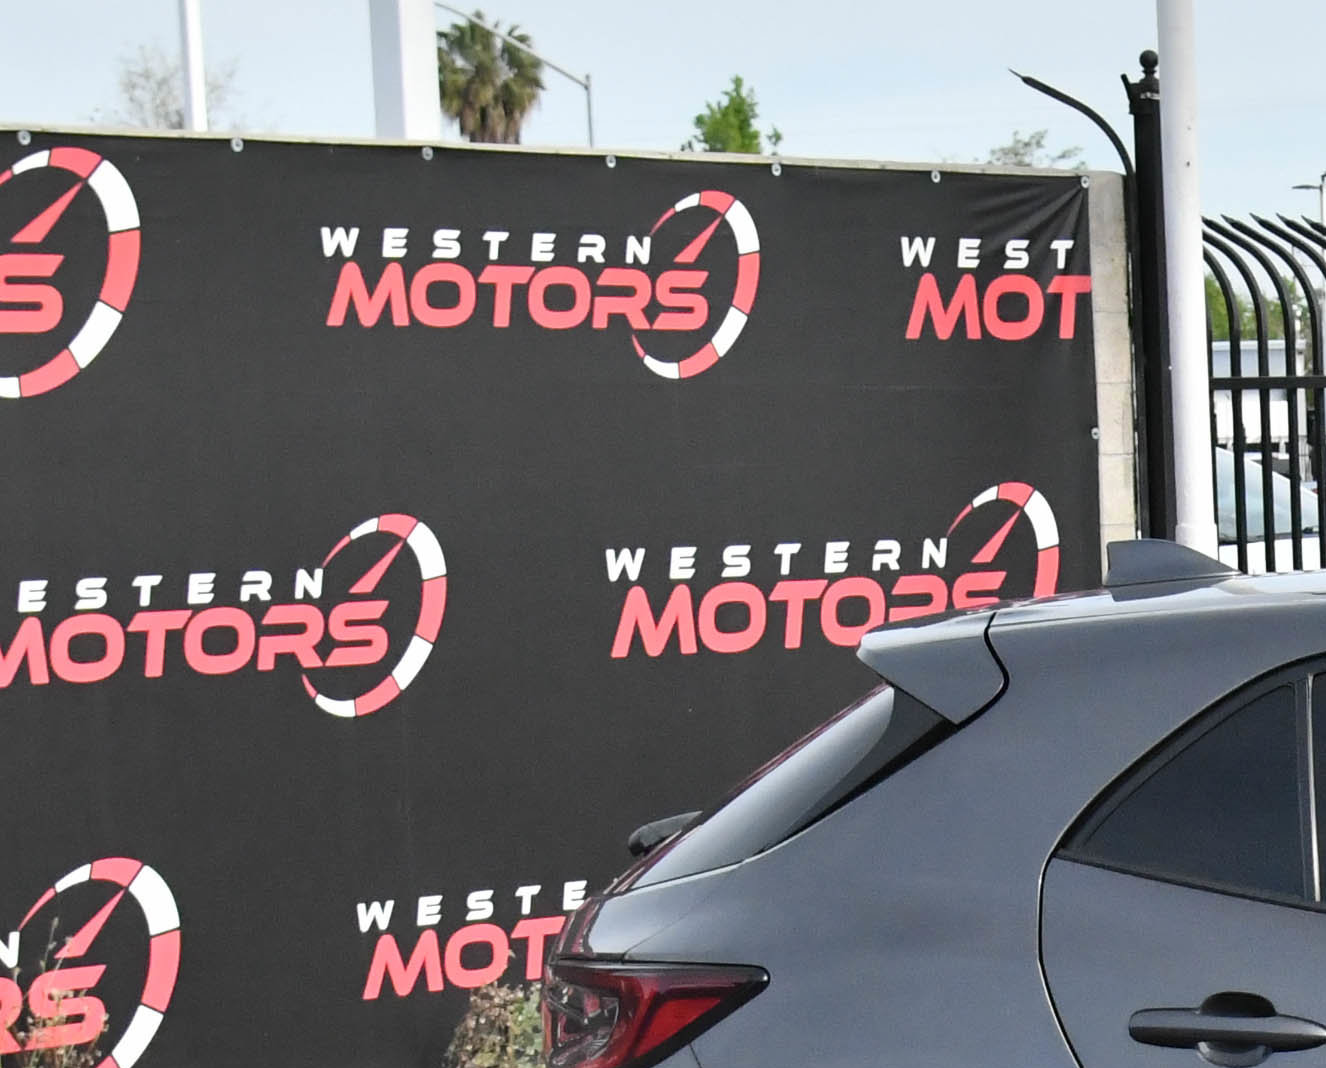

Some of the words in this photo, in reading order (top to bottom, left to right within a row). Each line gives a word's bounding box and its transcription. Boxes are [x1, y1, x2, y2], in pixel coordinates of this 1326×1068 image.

[320, 226, 651, 265] WESTERN
[900, 236, 1075, 270] WEST
[326, 261, 709, 331] MOTORS
[905, 273, 1092, 341] MOT
[605, 537, 948, 582] WESTERN
[356, 880, 588, 933] WESTE
[362, 916, 567, 1000] MOT
